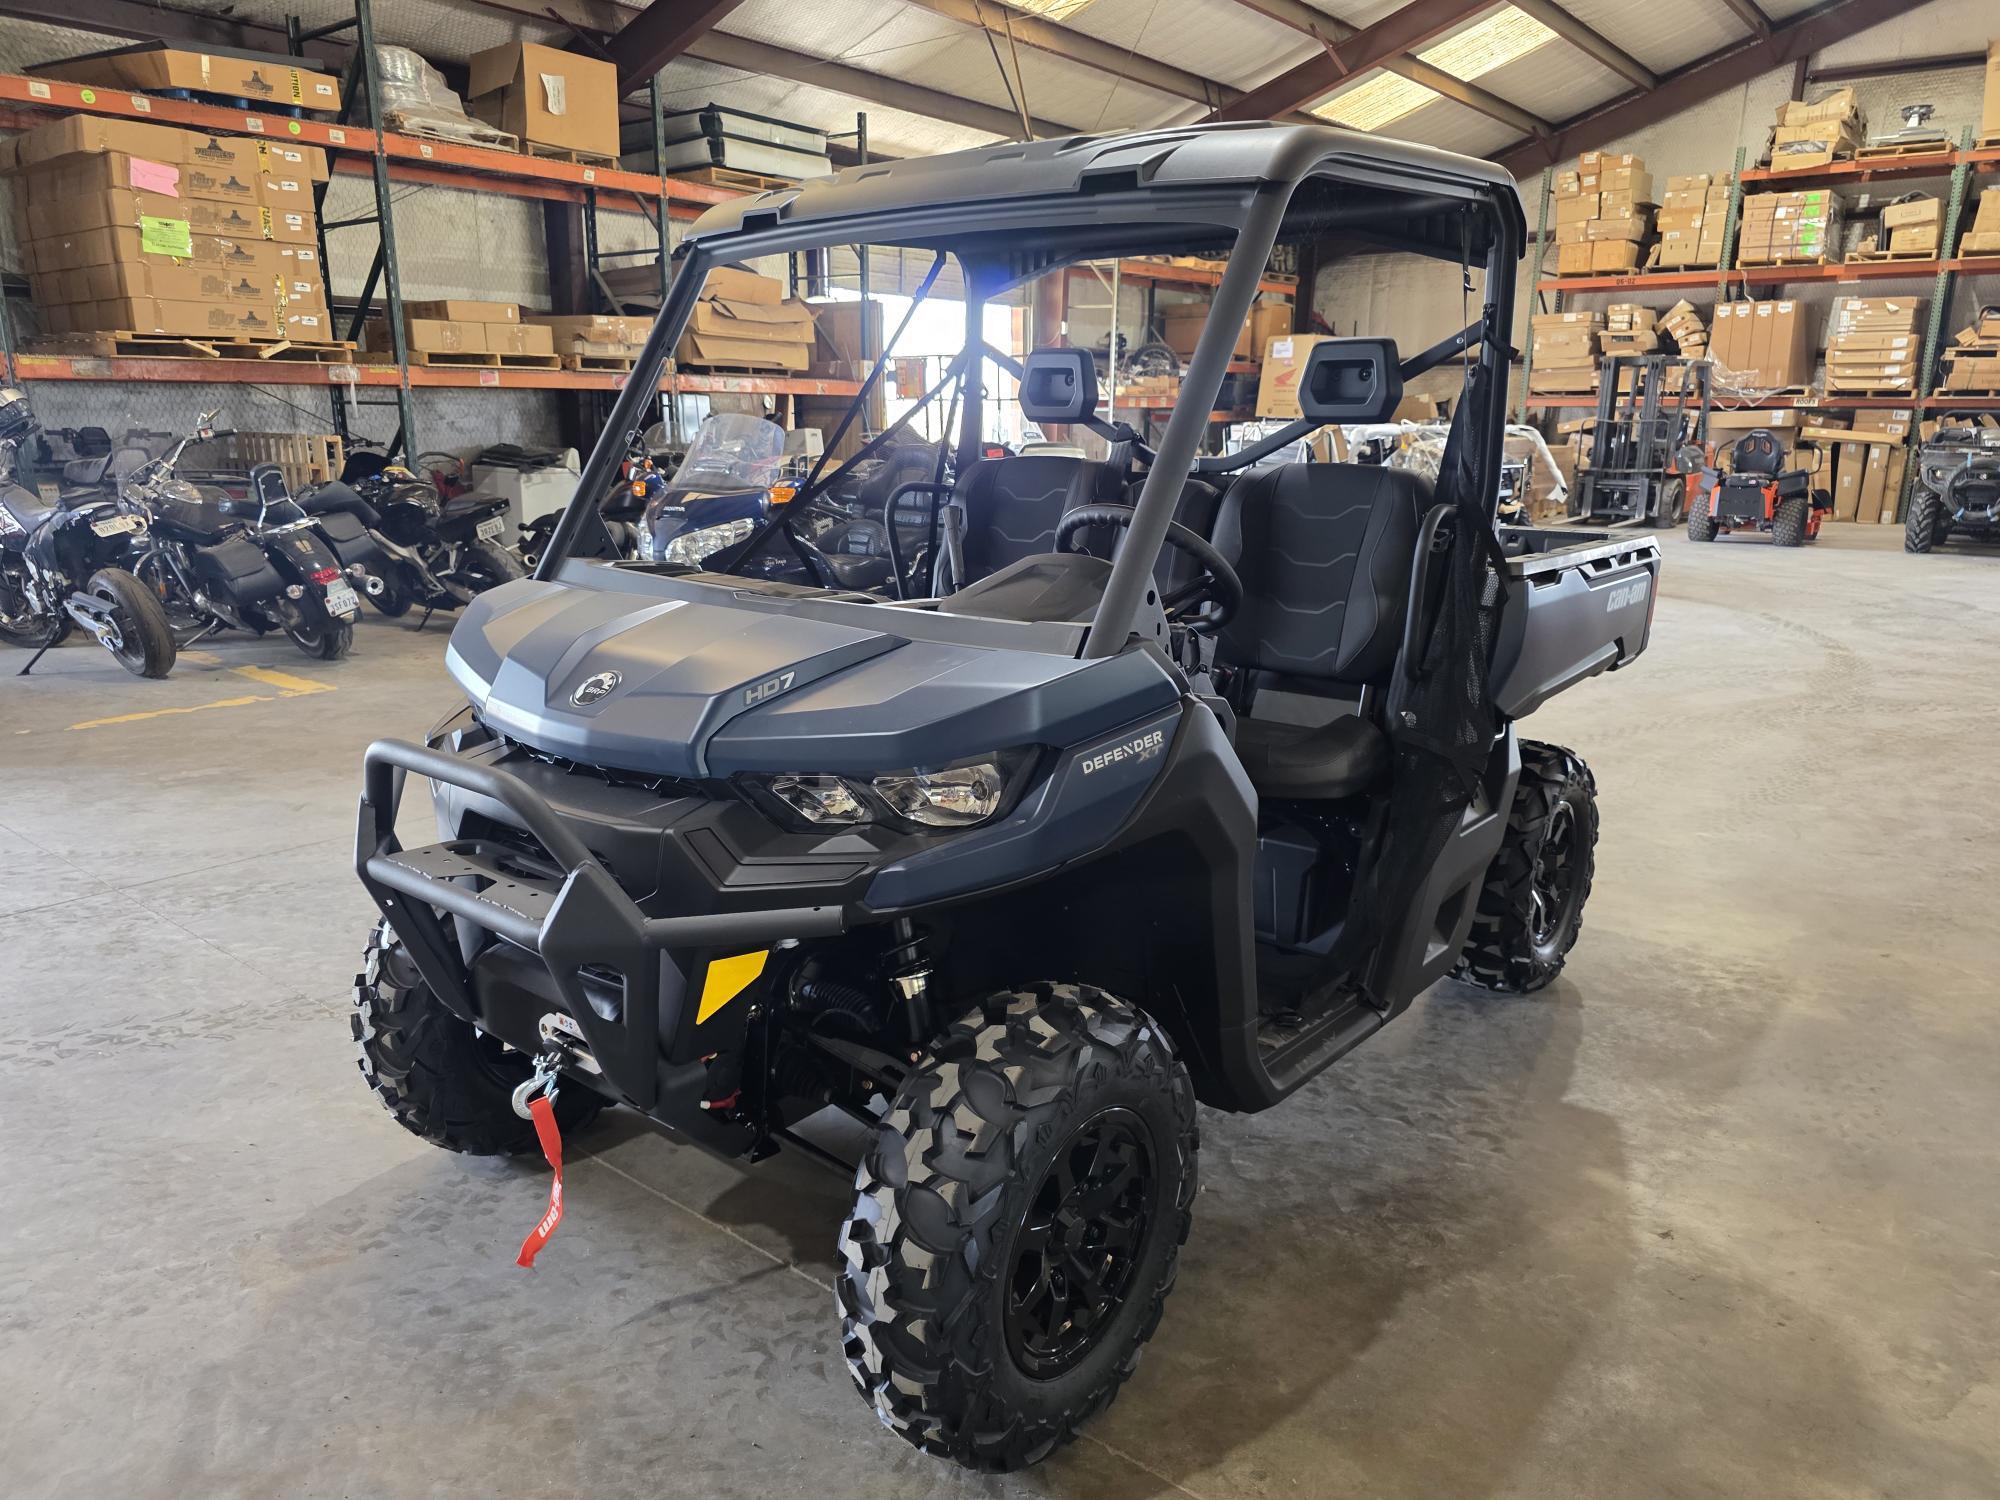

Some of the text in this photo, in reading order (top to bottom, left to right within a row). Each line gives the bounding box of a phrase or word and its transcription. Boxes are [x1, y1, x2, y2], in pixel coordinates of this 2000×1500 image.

[585, 686, 607, 695] BRP
[745, 671, 795, 705] HD7
[1082, 730, 1163, 774] DEFENDER
[1136, 742, 1165, 765] XT
